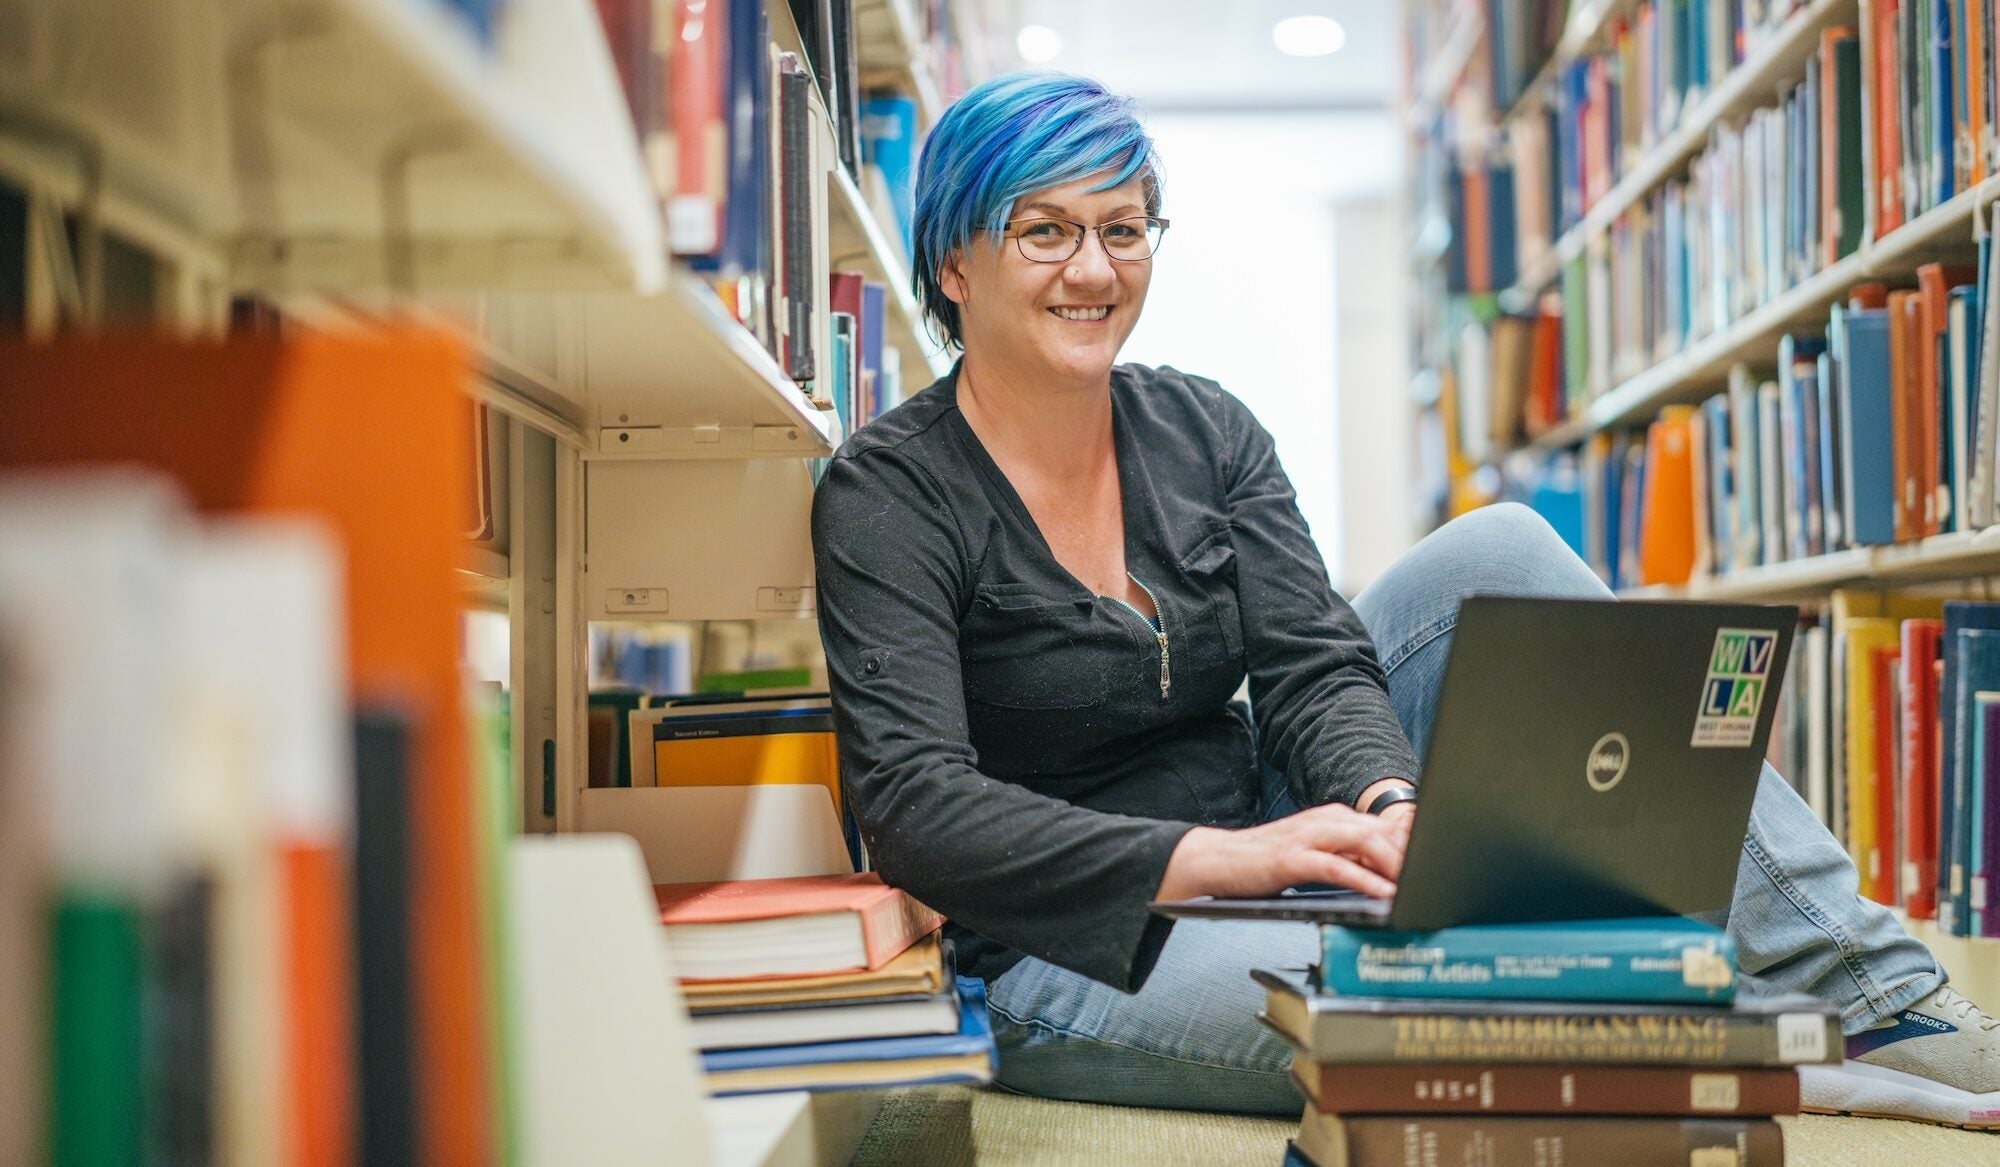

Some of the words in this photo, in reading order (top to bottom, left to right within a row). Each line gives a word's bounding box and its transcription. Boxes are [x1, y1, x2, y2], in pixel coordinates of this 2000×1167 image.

[1358, 943, 1444, 963] American
[1393, 1015, 1454, 1041] THE
[1463, 1015, 1634, 1041] AMERICAN
[1636, 1015, 1728, 1041] WING
[1904, 1012, 1949, 1032] BROOKS
